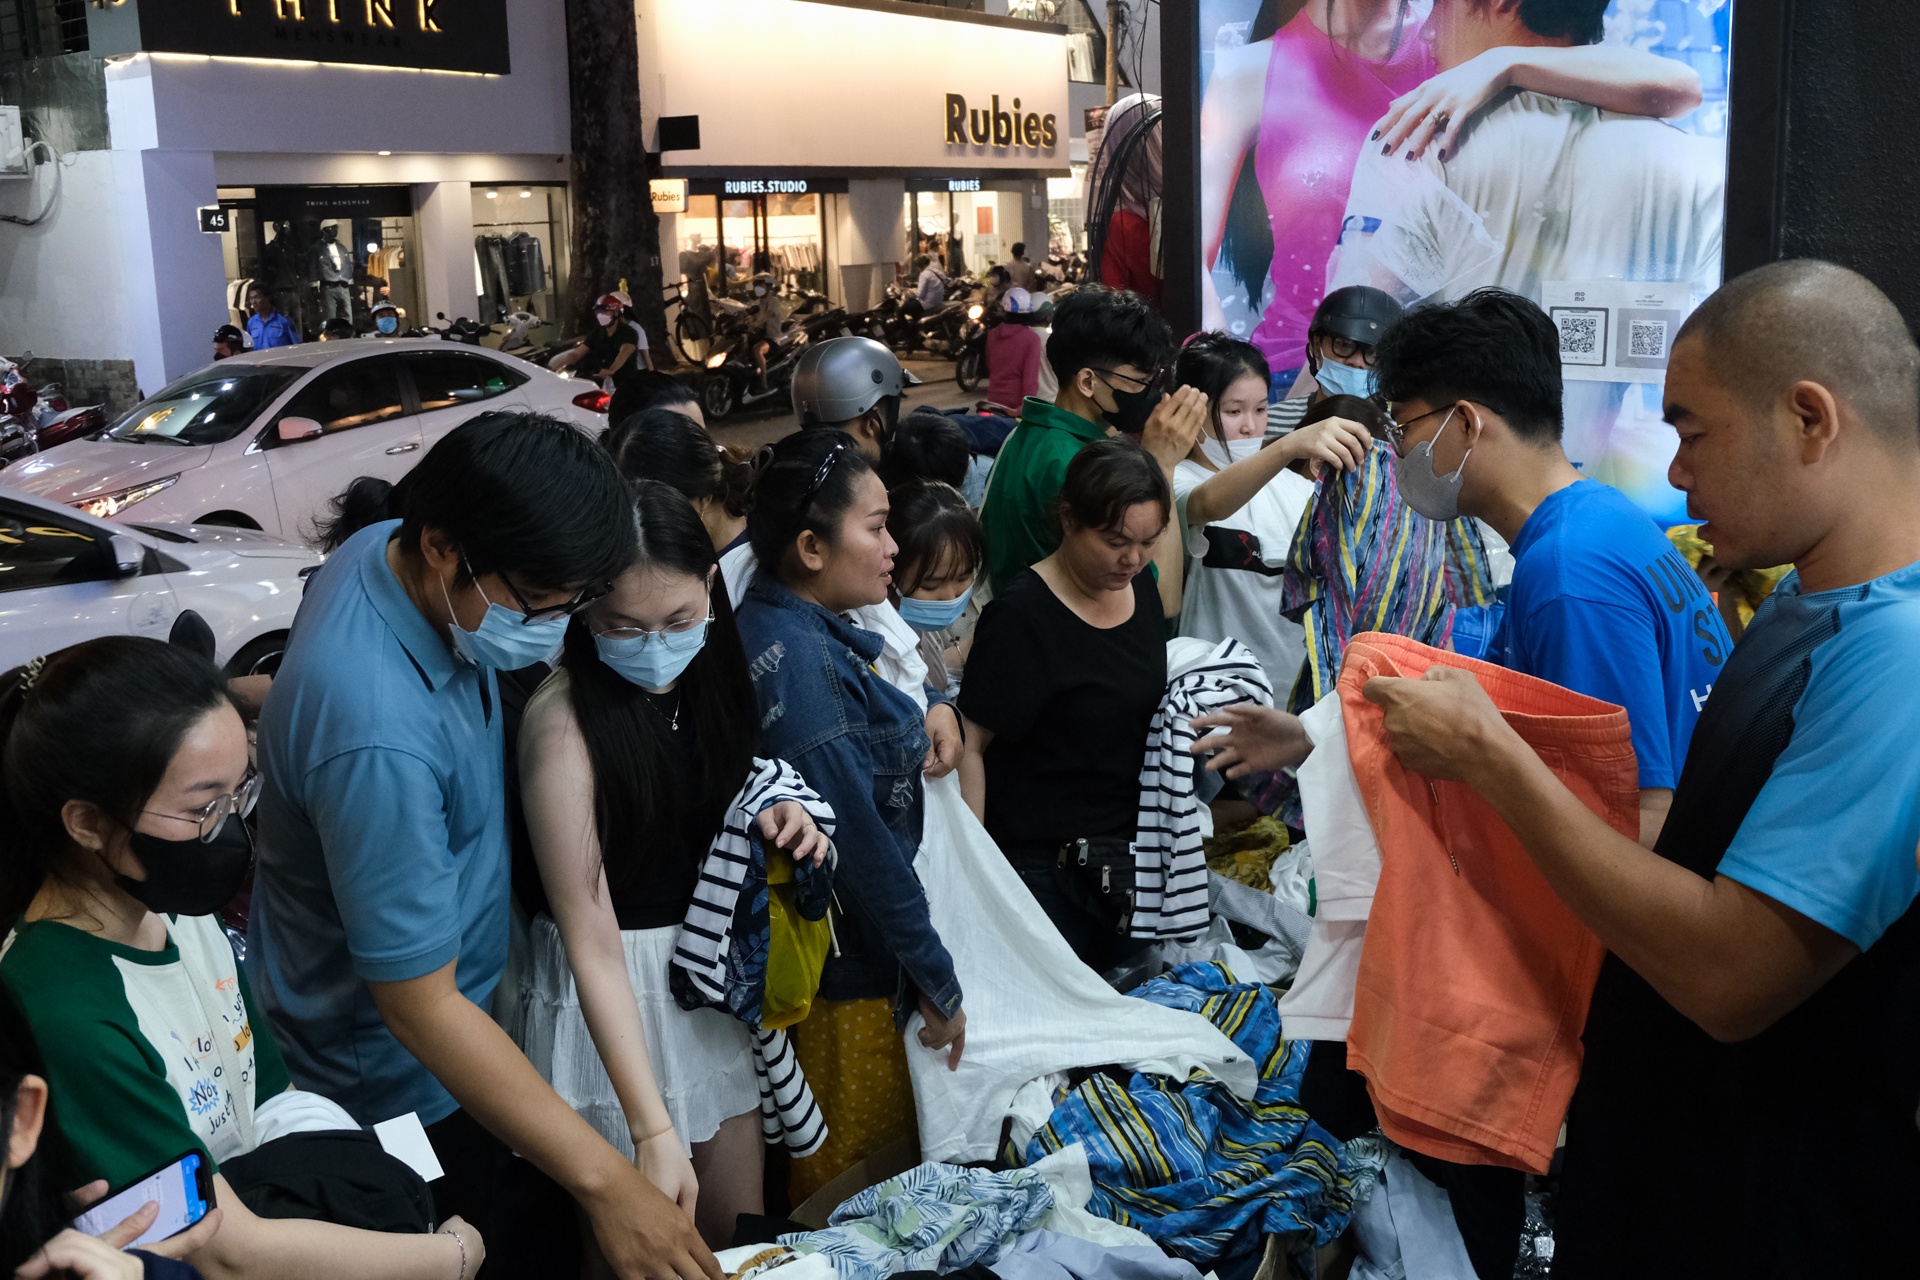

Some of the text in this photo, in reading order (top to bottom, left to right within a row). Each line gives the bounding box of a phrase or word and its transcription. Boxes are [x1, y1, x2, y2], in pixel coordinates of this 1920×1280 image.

[274, 26, 401, 49] MENSWEAR
[944, 92, 1058, 149] Rubies
[724, 179, 808, 194] RUBIES.STUDIO
[948, 179, 980, 192] RUBIES
[651, 191, 681, 202] Rubies
[209, 214, 225, 227] 45
[1690, 684, 1713, 713] H
